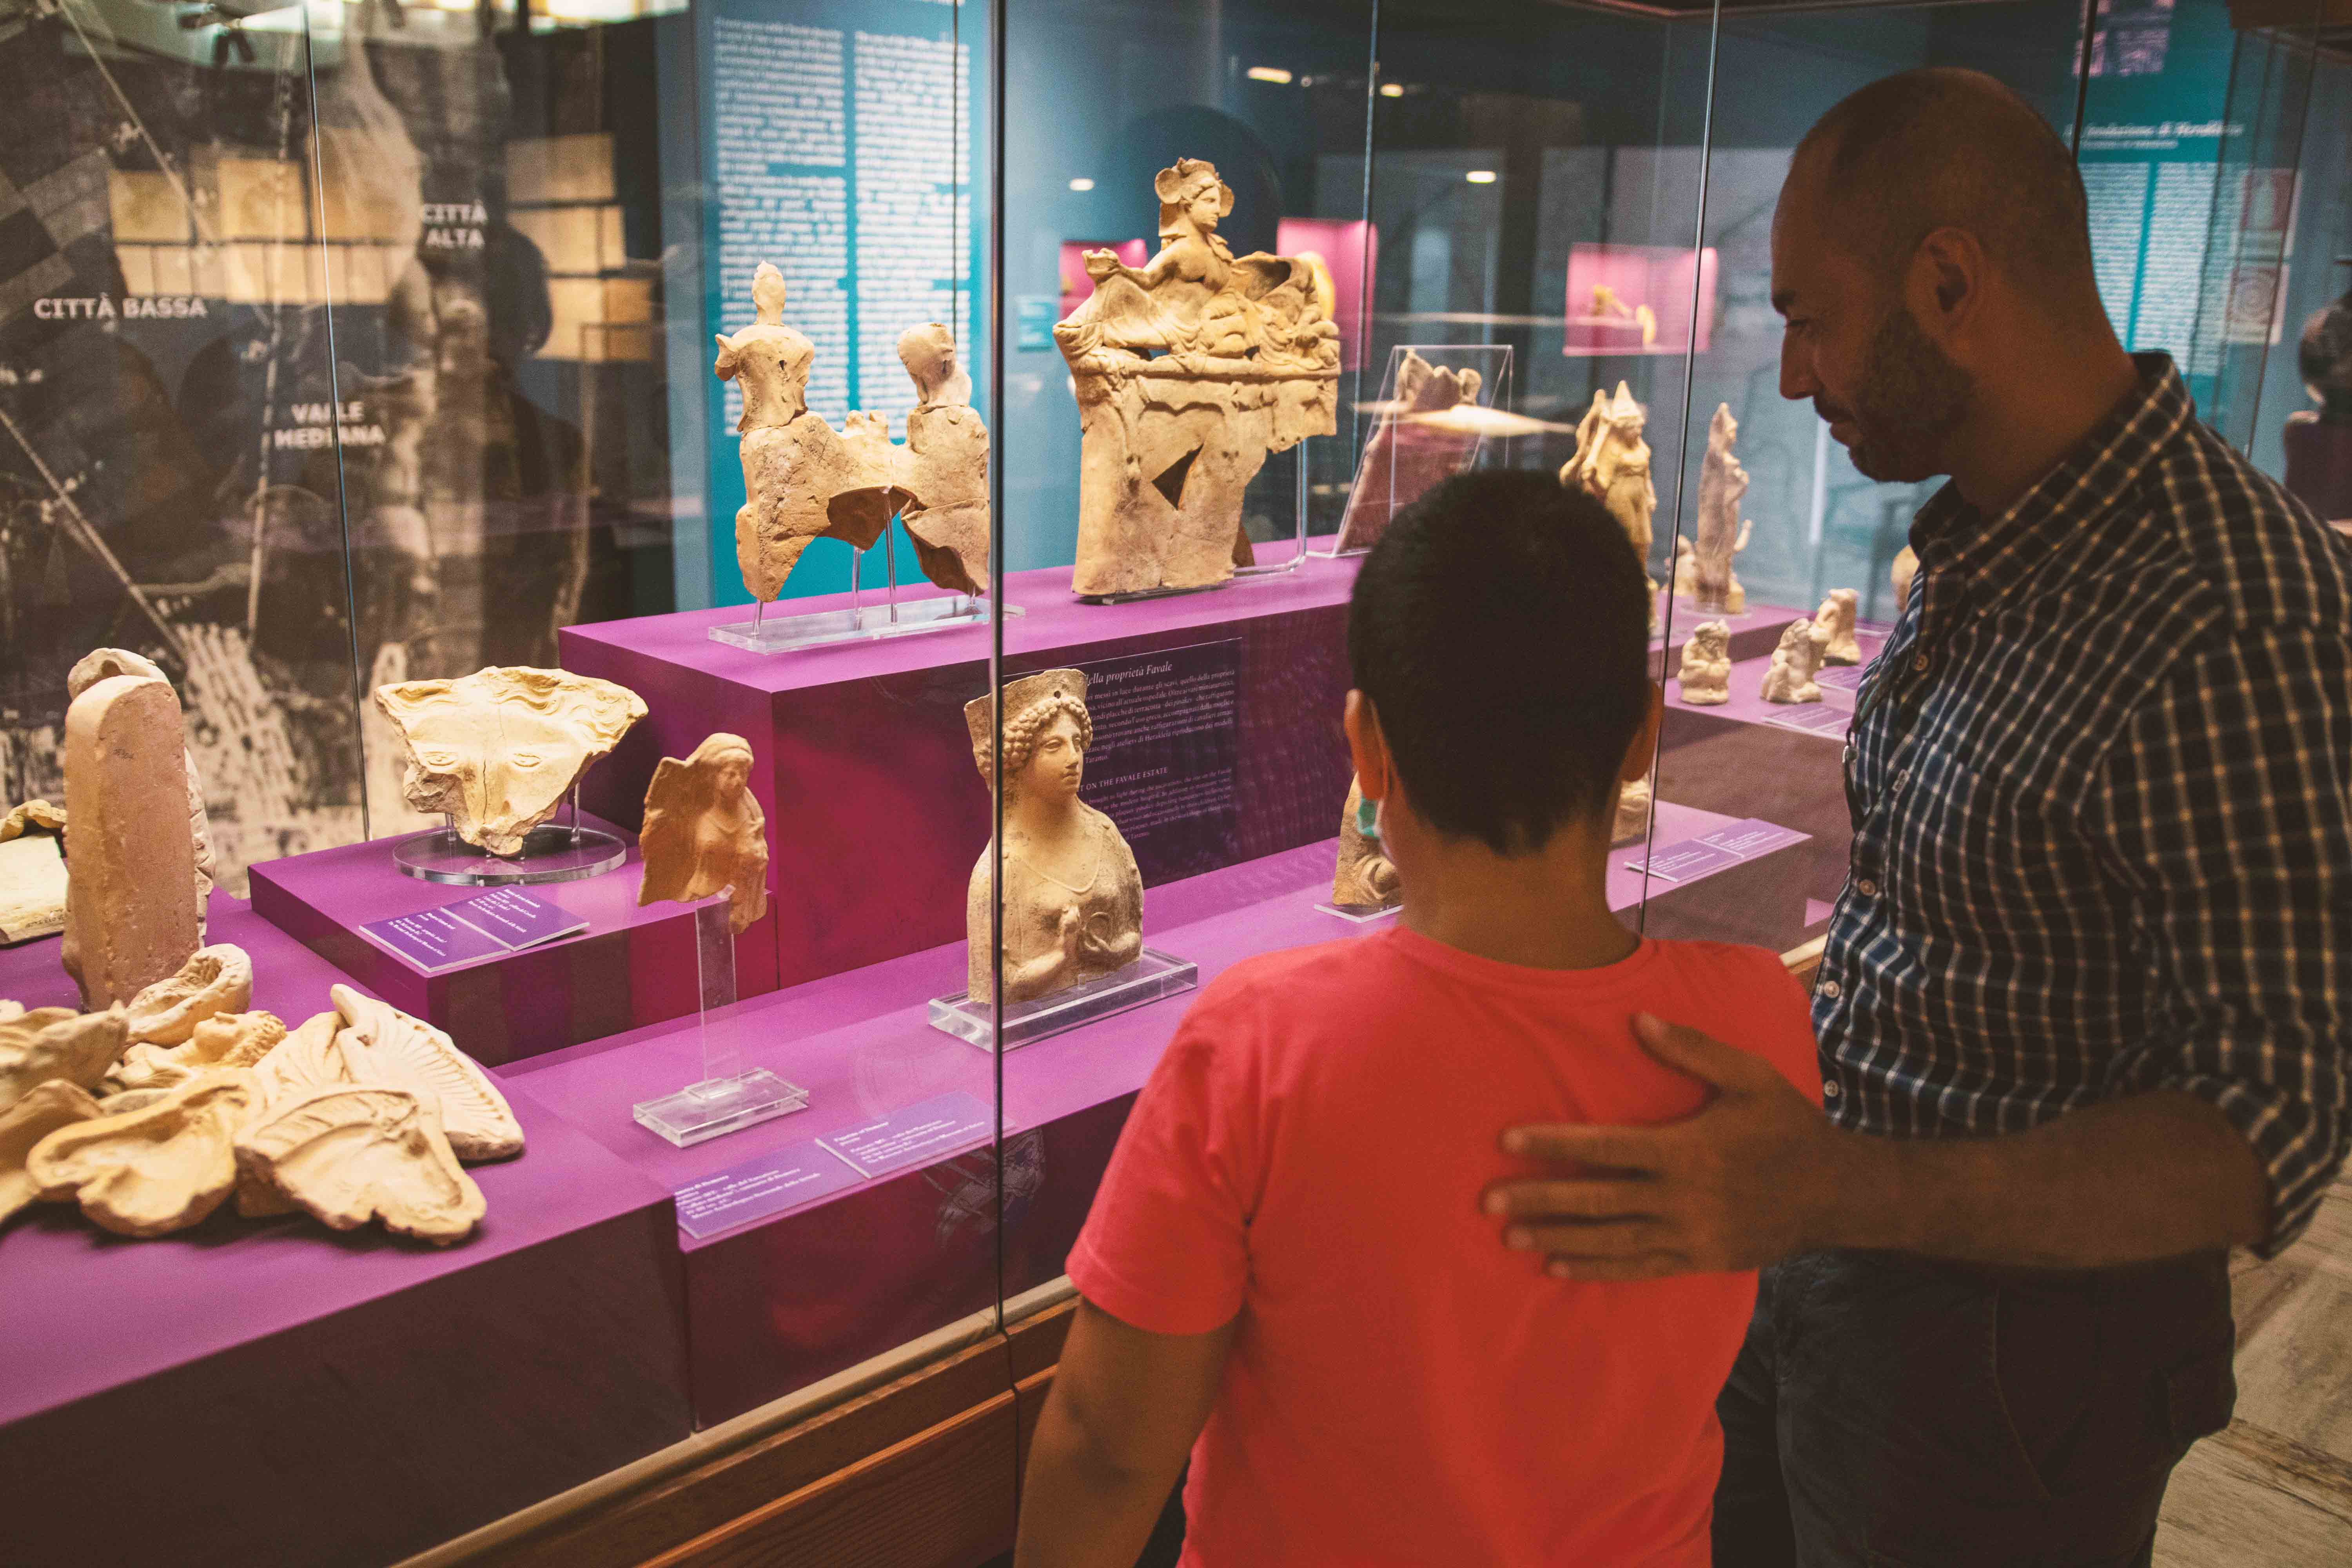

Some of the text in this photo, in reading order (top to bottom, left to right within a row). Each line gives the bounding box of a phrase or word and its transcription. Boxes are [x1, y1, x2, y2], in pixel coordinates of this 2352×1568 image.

[423, 198, 488, 224] CITTÀ
[426, 228, 485, 248] ALTA
[34, 292, 207, 319] CITTÀ BASSA
[1106, 666, 1143, 684] proprietà
[1146, 661, 1173, 675] Favale
[1094, 690, 1110, 699] messi
[1132, 683, 1153, 692] durante
[1091, 712, 1105, 720] randi
[1134, 702, 1160, 712] terracotta
[1109, 718, 1131, 727] secondo
[1085, 753, 1109, 763] Taranto.
[1099, 778, 1114, 787] THE
[1116, 773, 1141, 784] FAVALE
[1142, 767, 1168, 778] ESTATE
